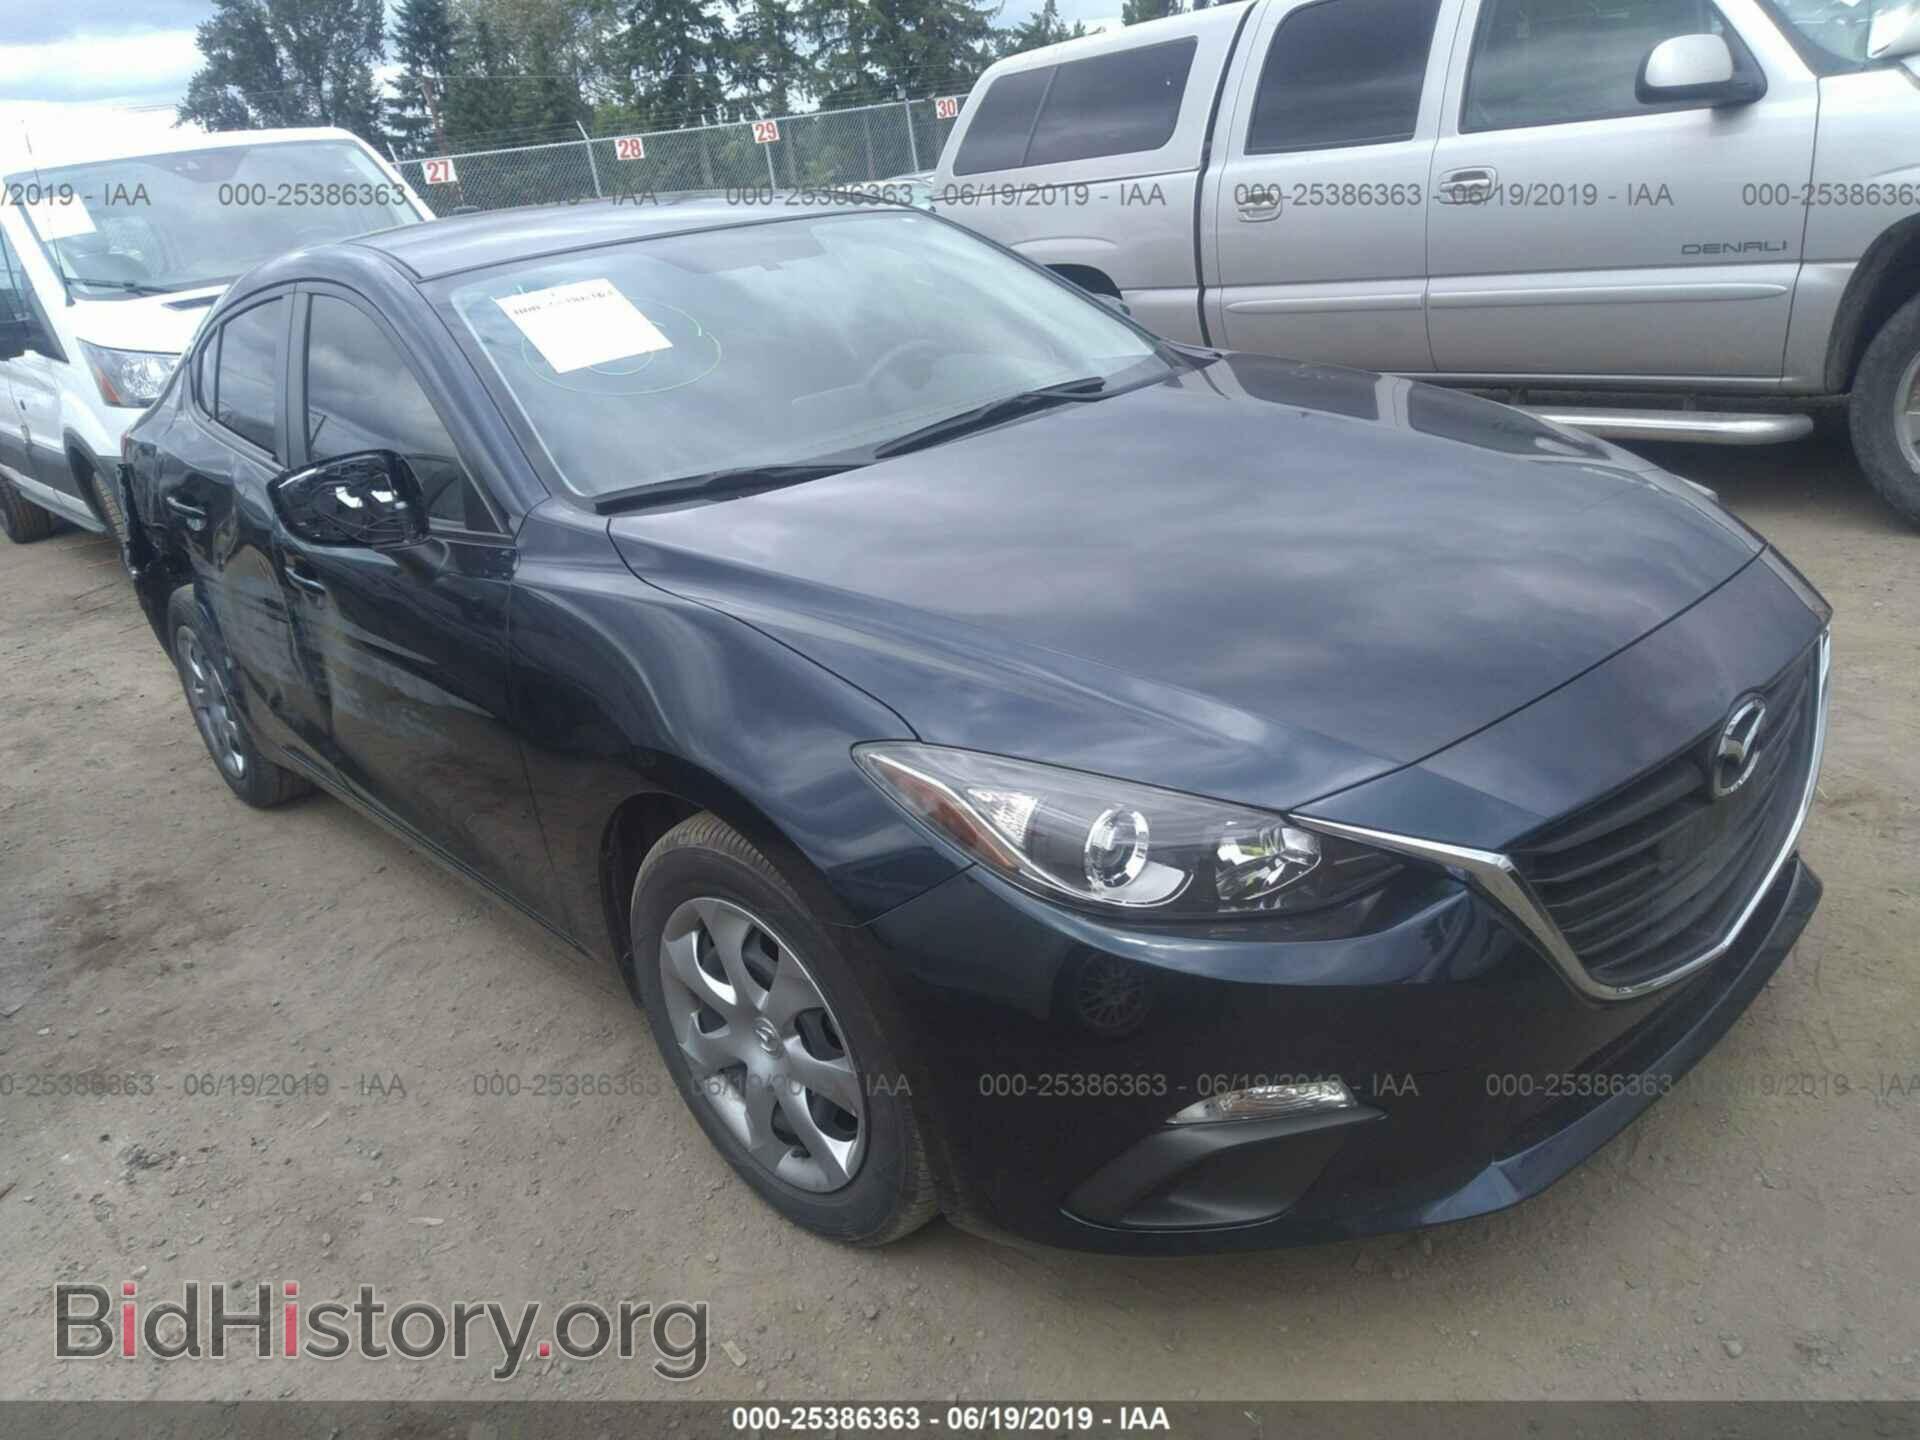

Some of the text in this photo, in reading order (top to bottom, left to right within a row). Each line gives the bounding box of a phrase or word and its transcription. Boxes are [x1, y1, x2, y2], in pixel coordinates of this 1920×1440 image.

[938, 100, 956, 117] 30
[755, 122, 776, 141] 29
[618, 139, 642, 158] 28
[427, 161, 449, 182] 27
[1681, 240, 1787, 255] DENALI
